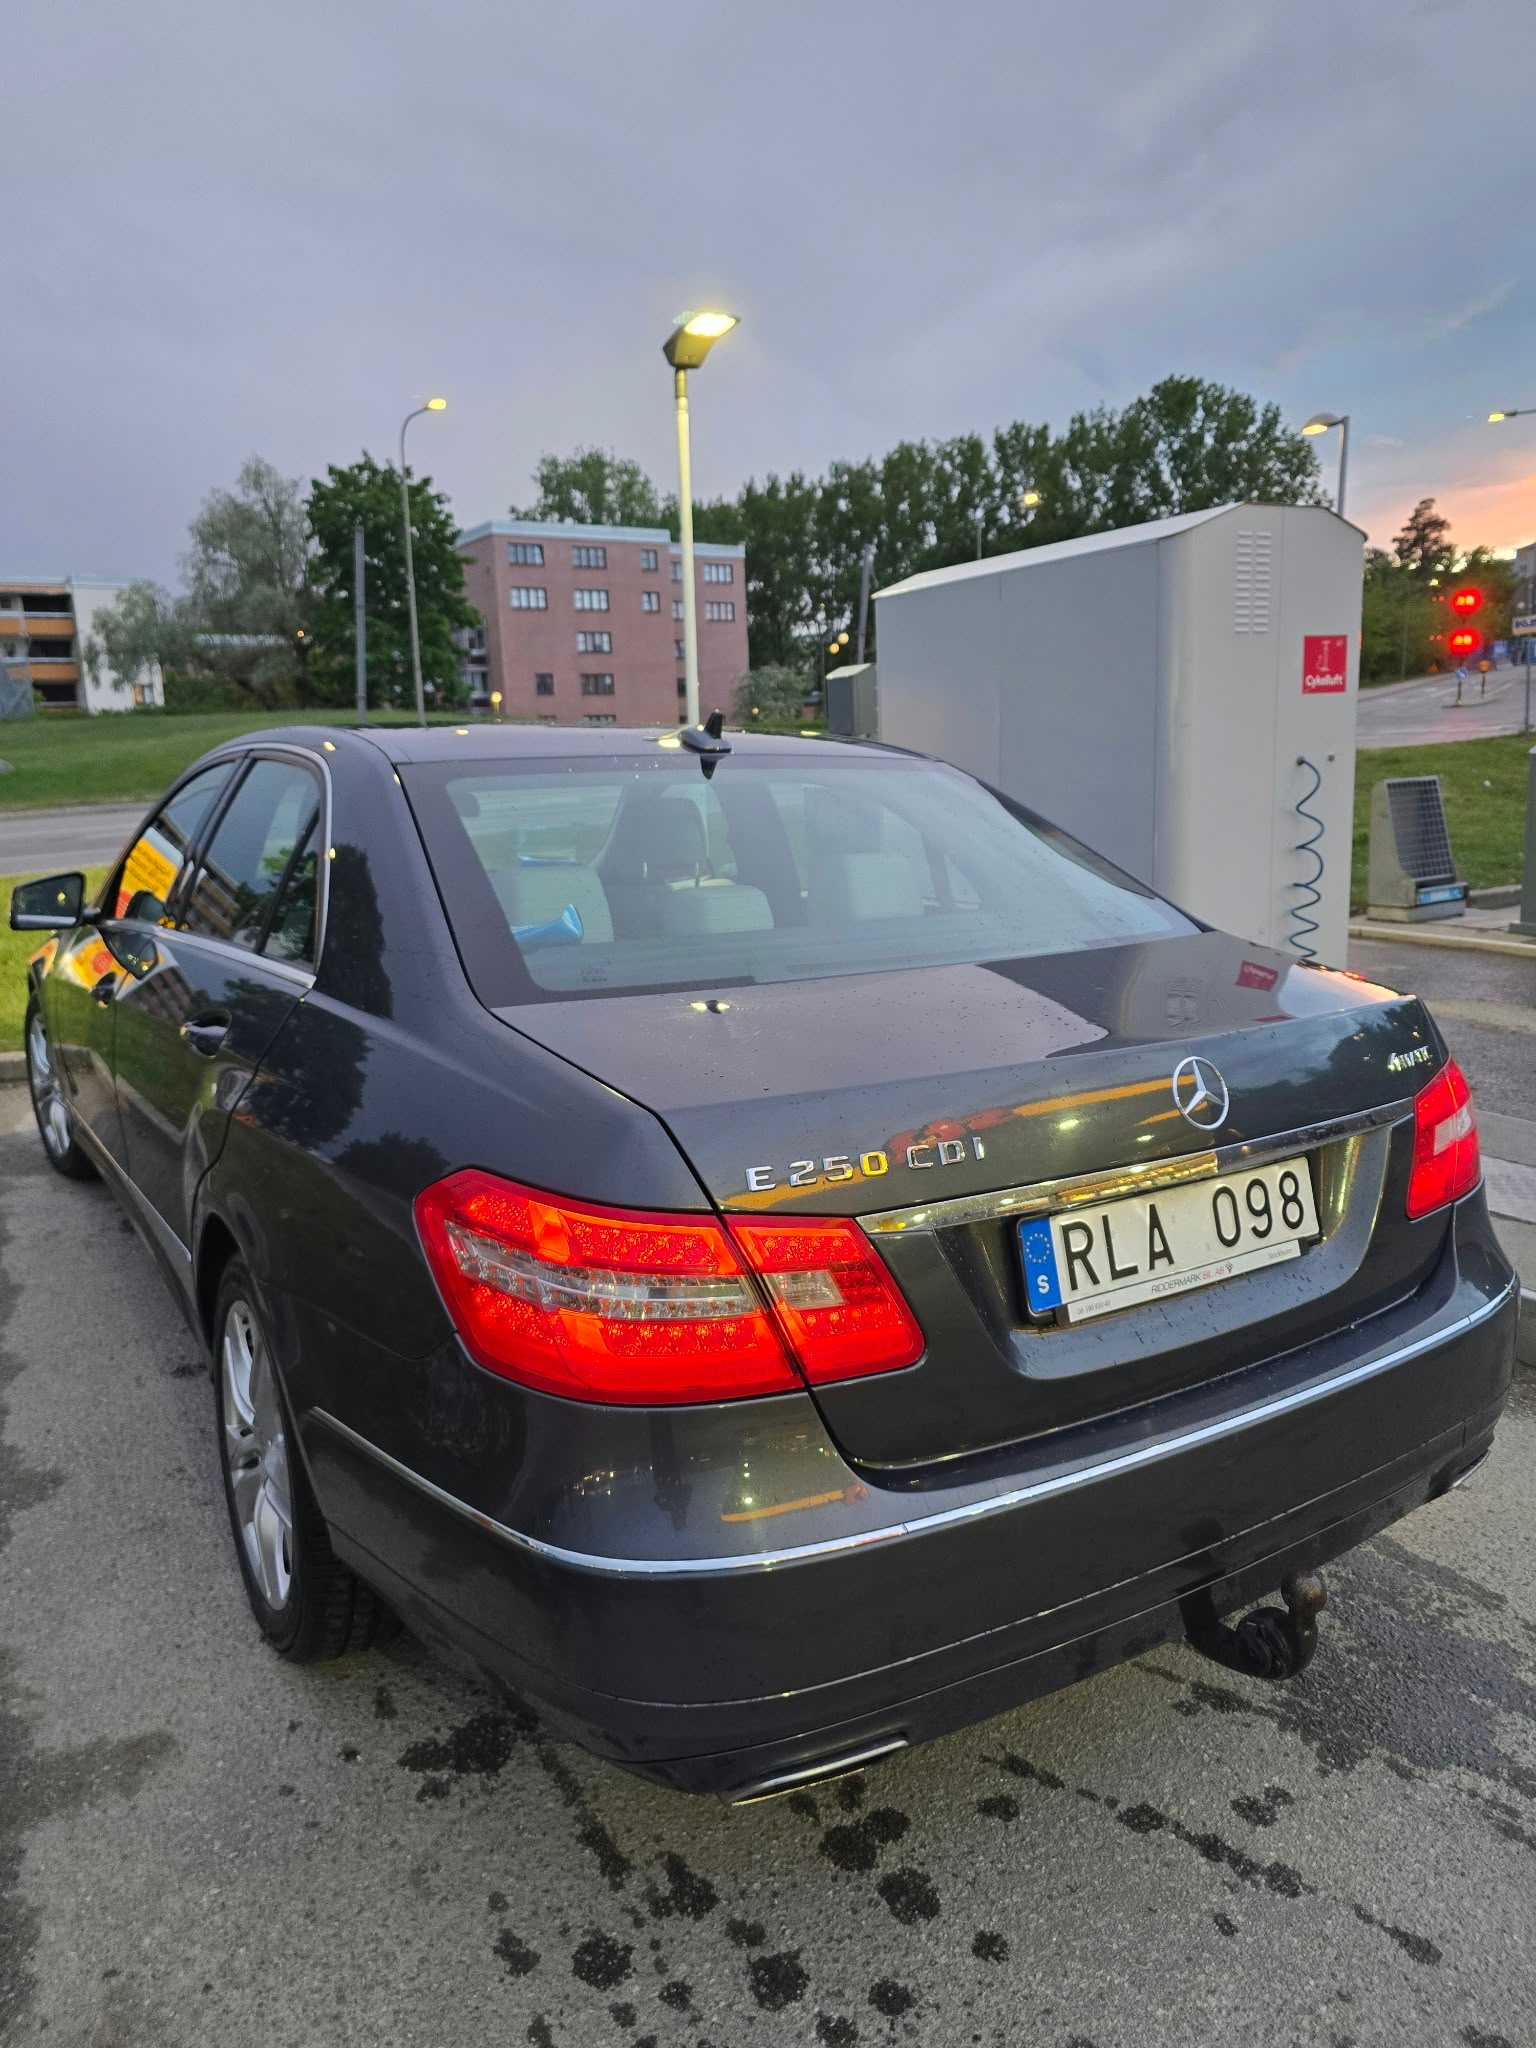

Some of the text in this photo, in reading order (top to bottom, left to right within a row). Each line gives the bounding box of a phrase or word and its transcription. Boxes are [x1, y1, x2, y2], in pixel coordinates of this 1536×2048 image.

[1305, 673, 1343, 689] Cykelluft
[745, 1136, 985, 1192] E 250 CDI
[1061, 1170, 1304, 1291] RLA 098
[1036, 1274, 1050, 1294] S
[1151, 1272, 1202, 1294] RIDDERMARK
[1215, 1265, 1225, 1276] AB
